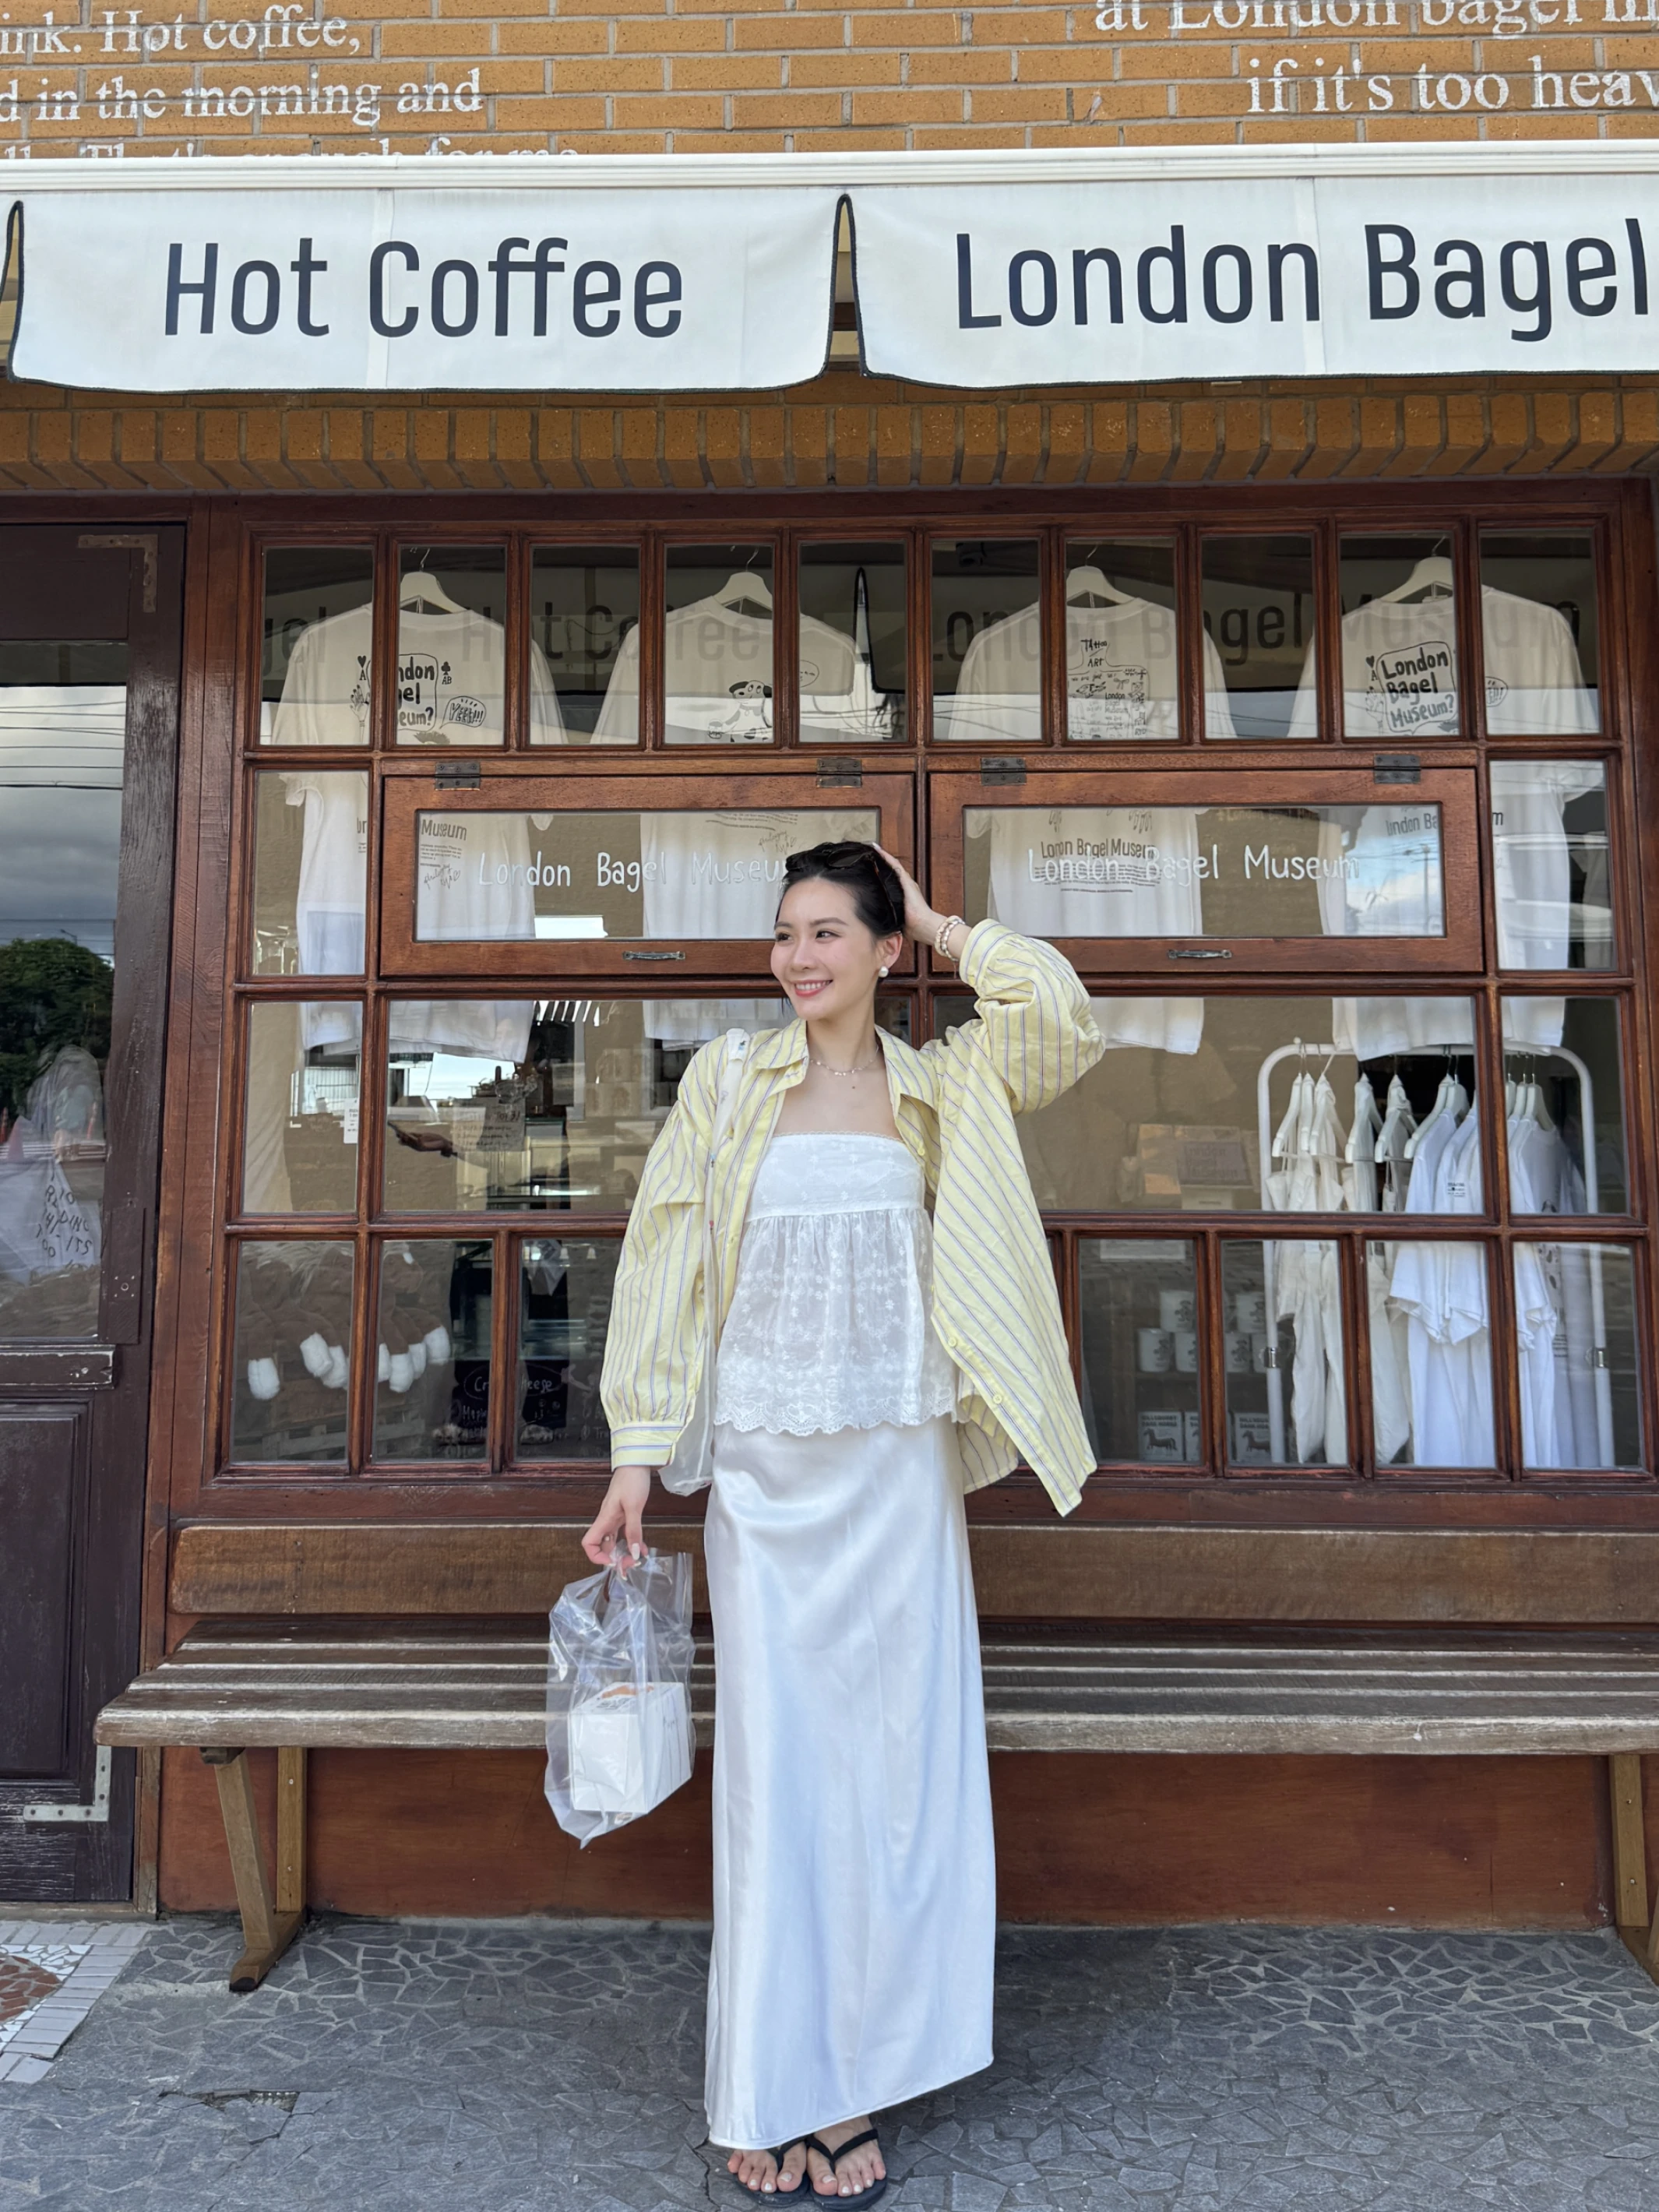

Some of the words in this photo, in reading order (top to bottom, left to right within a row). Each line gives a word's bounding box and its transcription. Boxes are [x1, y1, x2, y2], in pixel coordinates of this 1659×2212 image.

[100, 10, 188, 52] Hot
[203, 4, 361, 54] coffee,
[1094, 0, 1149, 30] at
[1168, 0, 1402, 30] London
[35, 78, 80, 121] in
[95, 76, 166, 119] the
[181, 72, 381, 127] morning
[397, 68, 484, 114] and
[1247, 58, 1298, 112] if
[1312, 57, 1395, 111] it's
[1416, 63, 1509, 110] too
[164, 238, 330, 337] Hot
[369, 237, 682, 338] Coffee
[956, 224, 1321, 330] London
[1364, 217, 1650, 343] Bagel
[398, 656, 435, 682] ndon
[442, 675, 452, 685] AB
[1087, 657, 1104, 668] ART
[1381, 646, 1449, 680] London
[1105, 692, 1125, 700] London
[1386, 671, 1439, 706] Bagel
[1390, 693, 1455, 728] Museum?
[479, 851, 571, 887] London
[597, 851, 667, 893] Bagel
[691, 851, 787, 886] Museu
[1028, 847, 1119, 882] London
[1146, 845, 1220, 887] Bagel
[1244, 844, 1361, 879] Museum
